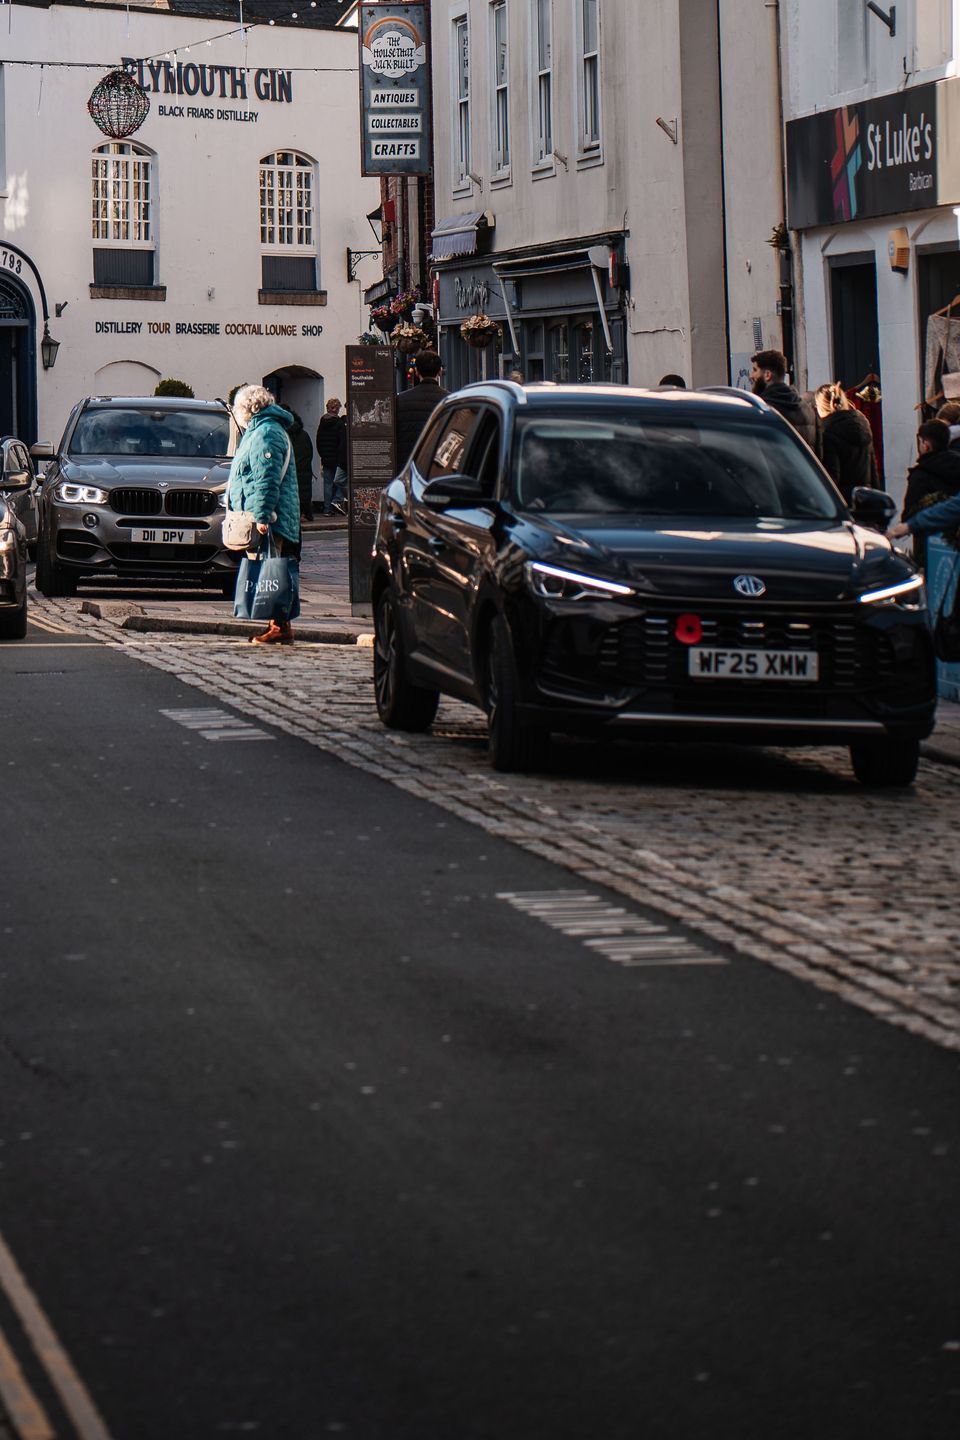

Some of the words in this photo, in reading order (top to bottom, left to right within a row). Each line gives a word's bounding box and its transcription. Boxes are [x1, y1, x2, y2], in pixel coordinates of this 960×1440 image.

[121, 57, 248, 100] PLYMOUTH
[254, 68, 293, 103] GIN
[373, 92, 416, 104] ANTIQUES
[158, 105, 185, 118] BLACK
[187, 107, 215, 120] FRIARS
[217, 109, 259, 123] DISTILLERY
[371, 118, 419, 129] COLLECTABLES
[374, 143, 417, 156] CRAFTS
[867, 123, 882, 171] St
[886, 113, 933, 167] Luke's
[909, 172, 933, 191] Barbican
[95, 321, 143, 334] DISTILLERY
[147, 322, 171, 335] TOUR
[175, 322, 220, 335] BRASSERIE
[224, 323, 264, 336] COCKTAIL
[265, 324, 298, 336] LOUNGE
[301, 325, 323, 337] SHOP
[162, 531, 185, 542] DPV
[698, 650, 759, 675] WF25
[764, 652, 808, 677] XMW
